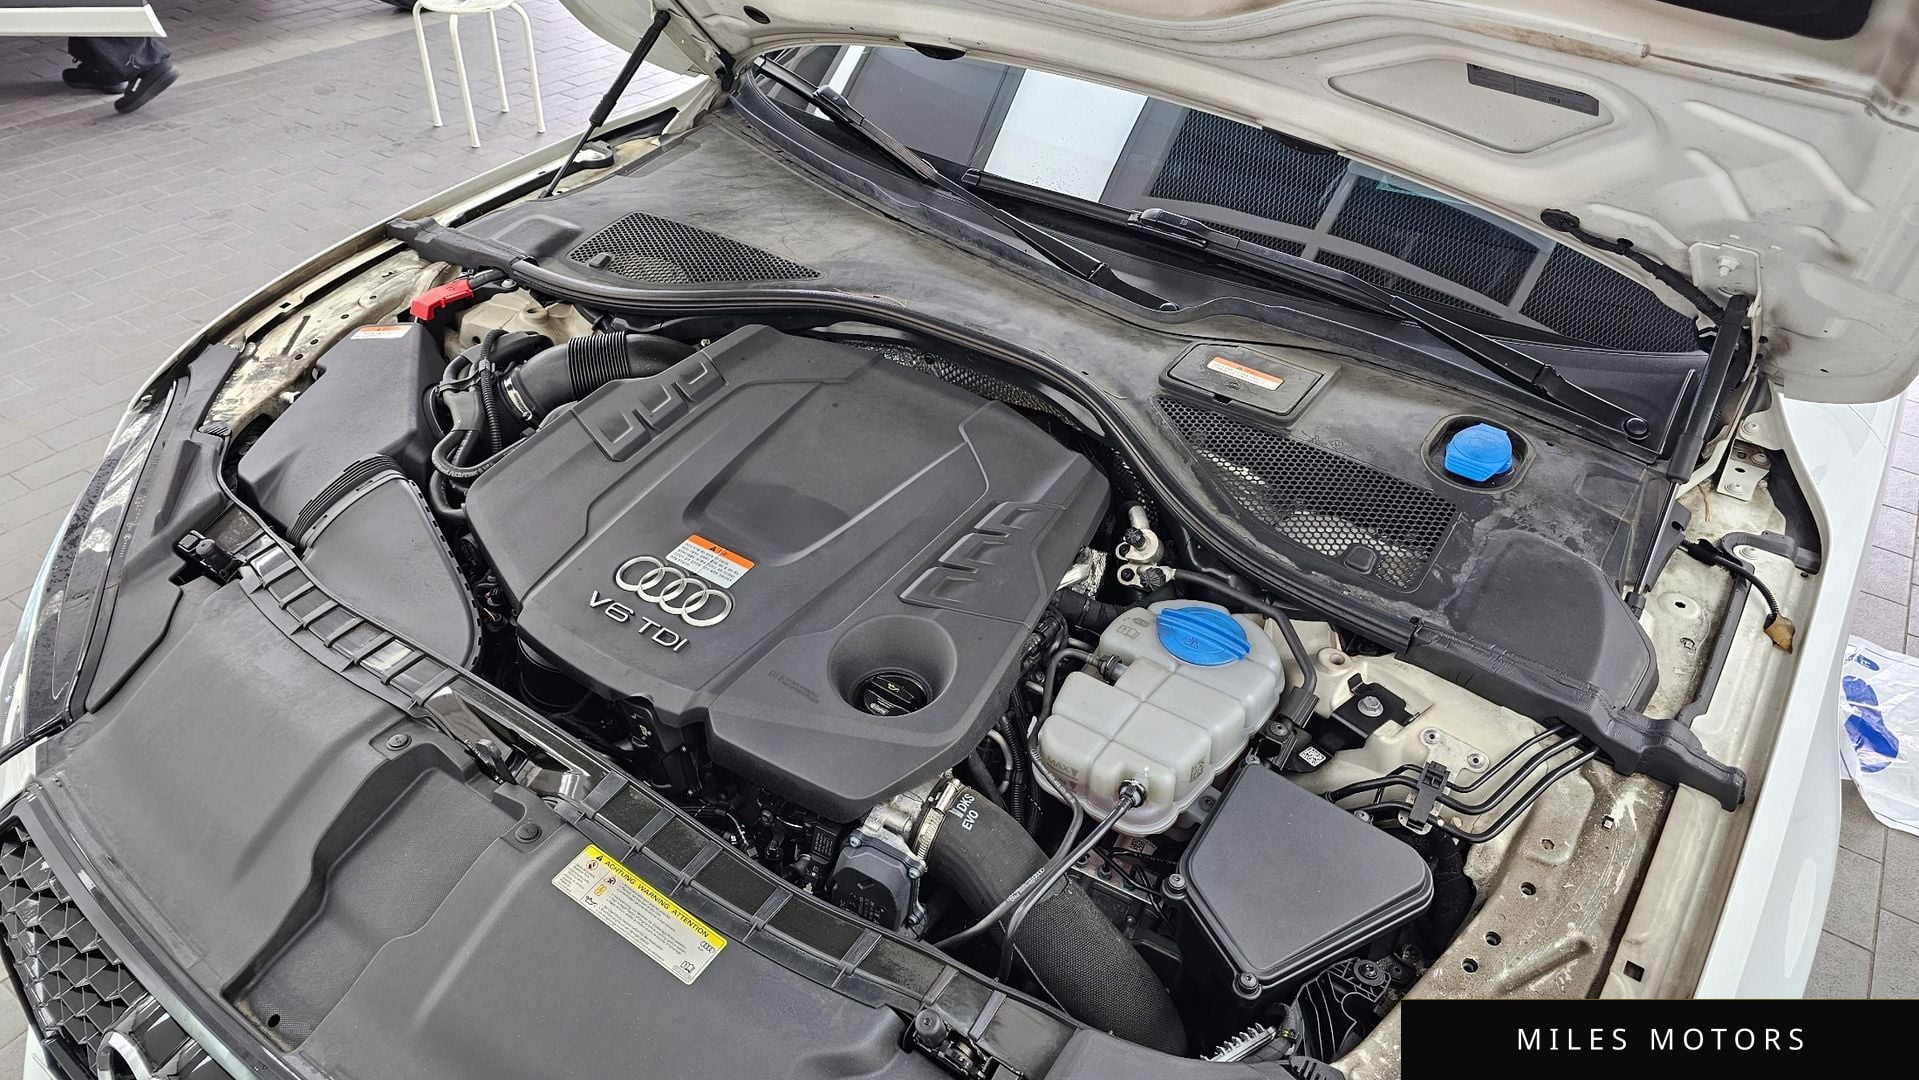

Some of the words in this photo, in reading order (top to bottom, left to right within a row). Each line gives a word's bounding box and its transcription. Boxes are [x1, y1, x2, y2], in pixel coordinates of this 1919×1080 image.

[589, 590, 635, 623] V6
[638, 616, 688, 652] TDI
[1047, 755, 1070, 772] MAX
[956, 793, 975, 813] DKS
[962, 809, 979, 831] EVO
[604, 861, 636, 886] ACHTUNG
[637, 883, 671, 910] WARNING
[671, 909, 710, 938] ATTENTION
